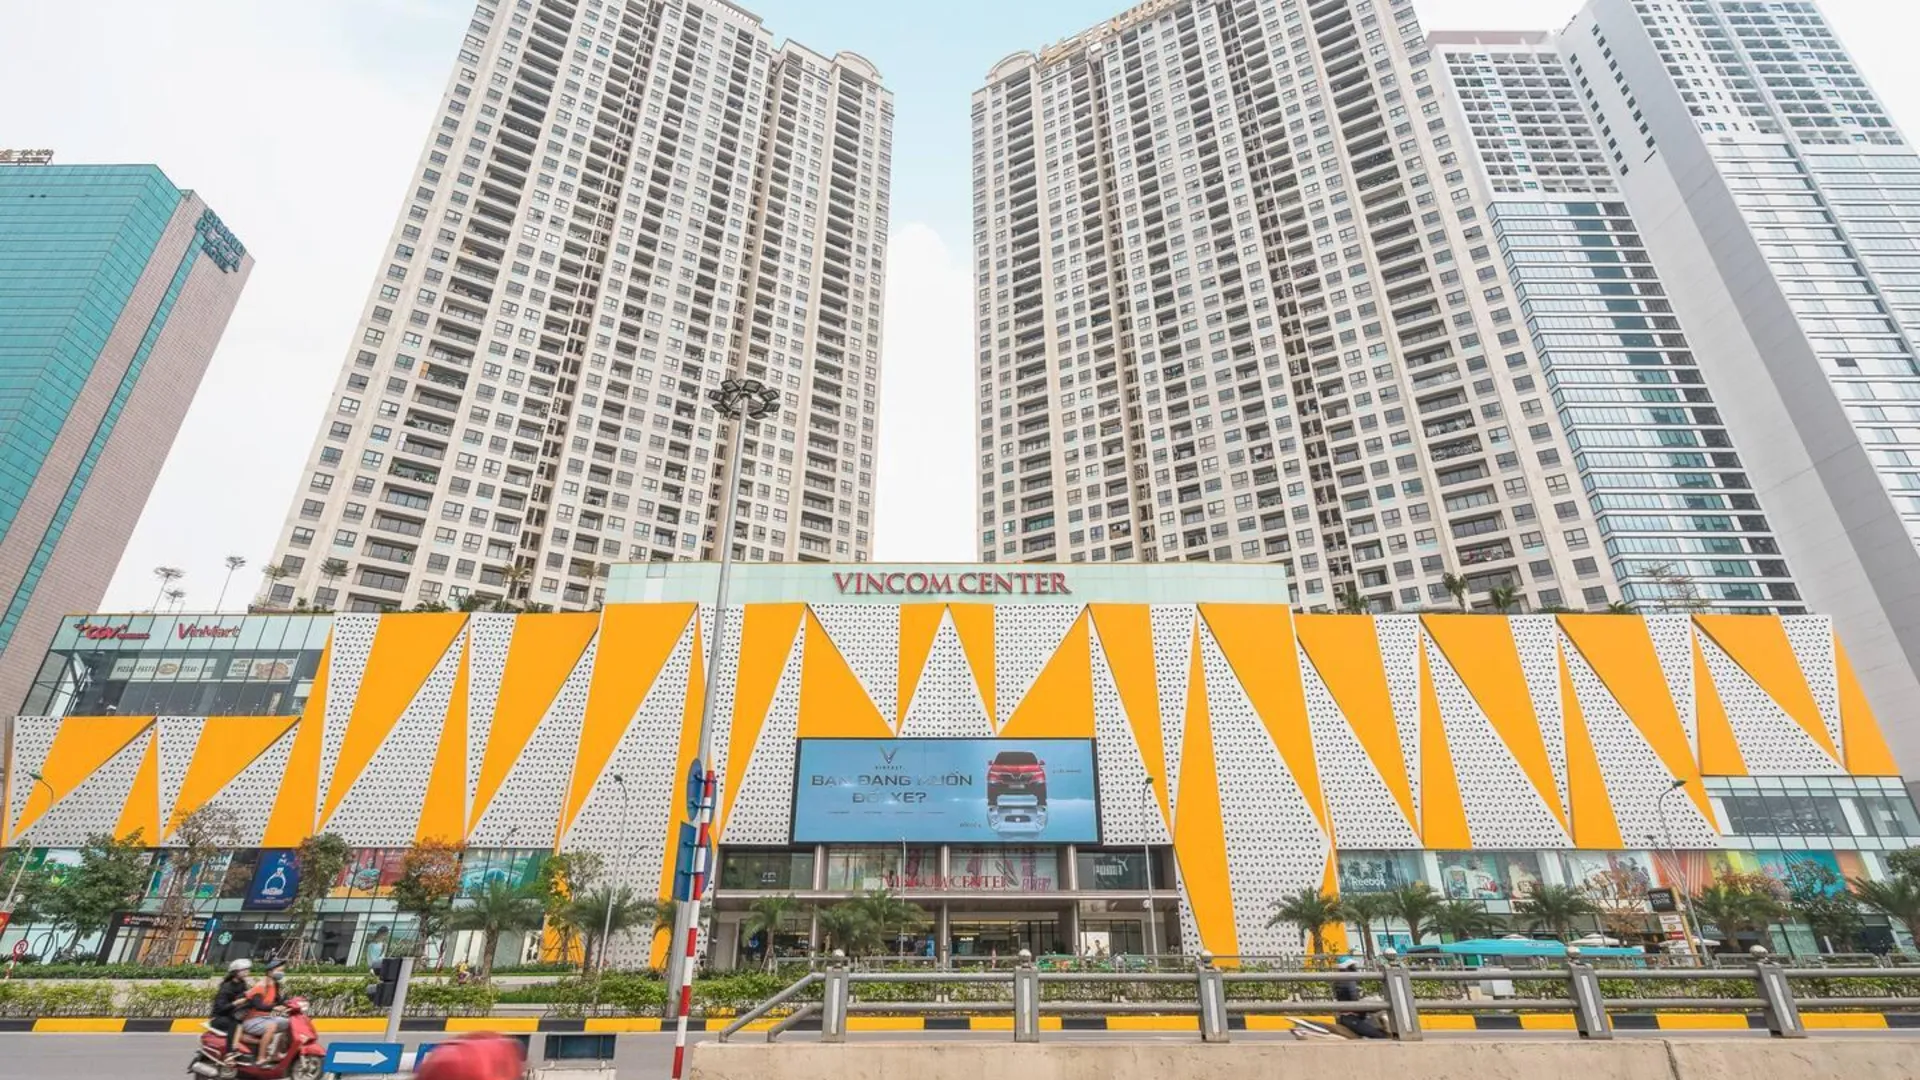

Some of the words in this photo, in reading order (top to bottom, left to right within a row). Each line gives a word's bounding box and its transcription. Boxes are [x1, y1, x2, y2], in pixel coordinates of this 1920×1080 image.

[832, 571, 955, 595] VINCOM
[958, 571, 1072, 595] CENTER
[177, 623, 241, 639] VinMart
[1352, 879, 1386, 889] Reebok
